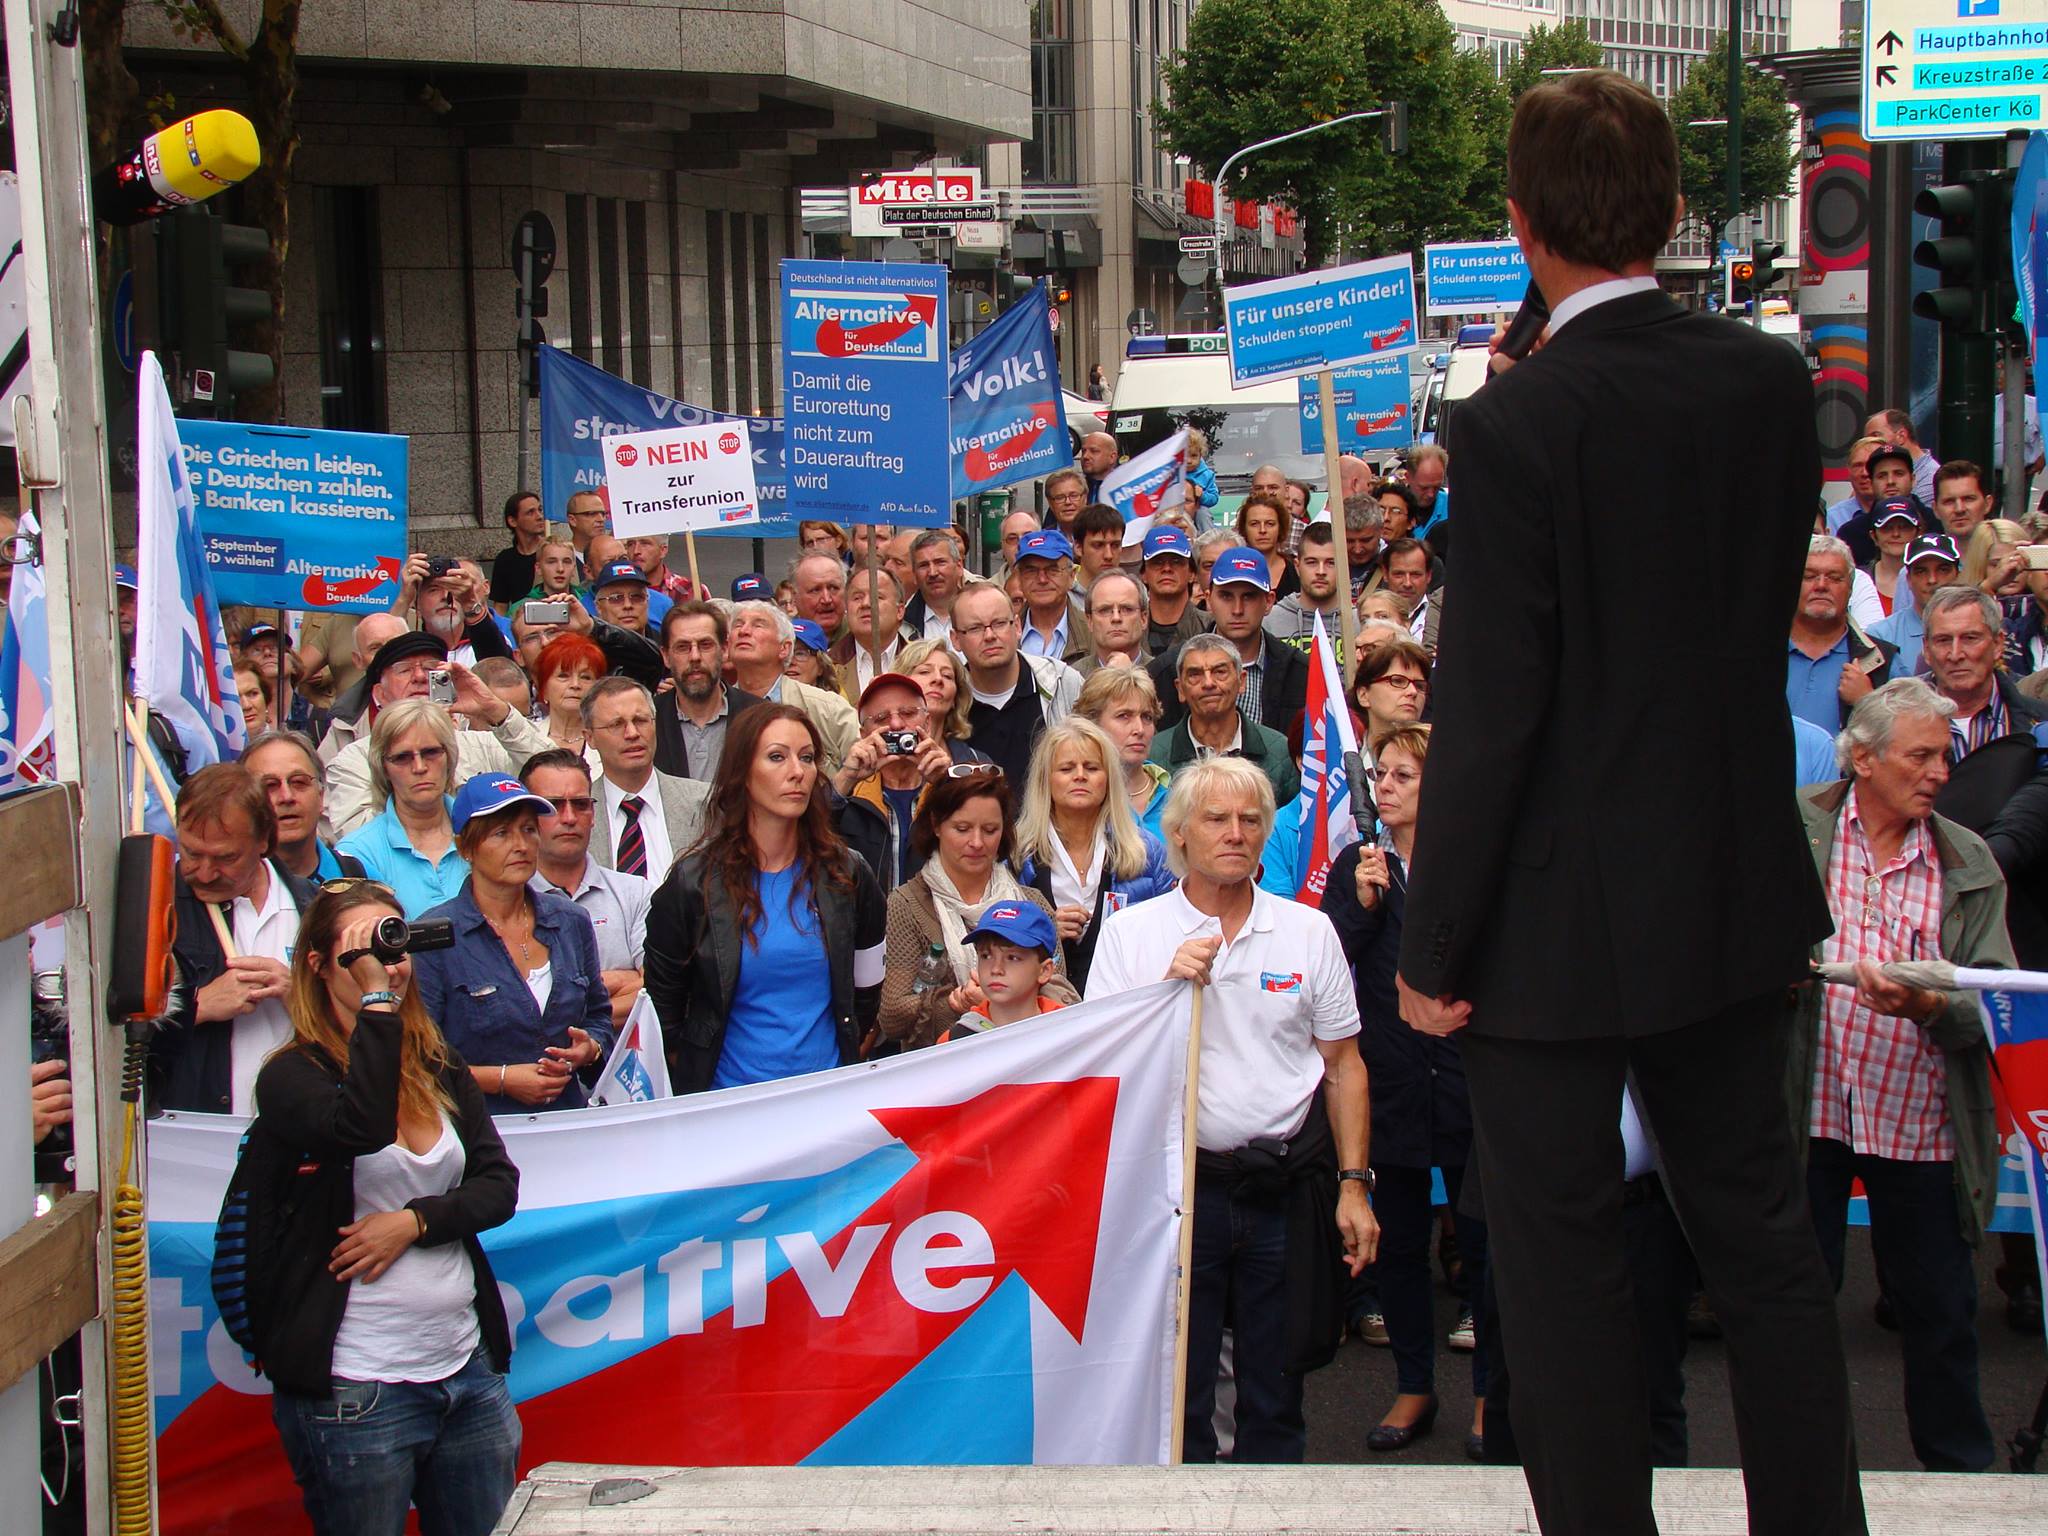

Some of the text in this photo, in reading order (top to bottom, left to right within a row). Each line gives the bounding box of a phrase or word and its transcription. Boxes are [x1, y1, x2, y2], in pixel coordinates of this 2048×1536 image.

[1919, 65, 2034, 85] Kreuzstraße
[1896, 100, 2032, 121] ParkCenter Kö
[864, 180, 968, 201] Miele
[885, 208, 991, 221] Platz der Deutschen Einheit
[1432, 253, 1527, 269] Für unsere Ki
[790, 273, 937, 288] Deutschland ist nicht alternativlos!
[1433, 272, 1521, 284] Schulden stoppen!
[1236, 279, 1405, 327] Für unsere Kinder!
[795, 301, 923, 325] Alternative
[844, 331, 858, 340] für
[1239, 316, 1353, 349] Schulden stoppen!
[1363, 325, 1407, 339] Alternative
[844, 341, 923, 355] Deutschland
[1190, 339, 1227, 351] POL
[962, 350, 1047, 402] Volk!
[1375, 364, 1402, 376] wird.
[792, 371, 872, 392] Damit die
[793, 396, 891, 421] Eurorettung
[1346, 409, 1402, 422] Alternative
[793, 424, 873, 443] nicht zum
[719, 438, 740, 450] STOP
[617, 450, 637, 462] STOP
[647, 440, 709, 466] NEIN
[793, 447, 904, 473] Dauerauftrag
[988, 453, 999, 461] für
[989, 444, 1055, 471] Deutschland
[217, 447, 309, 472] Griechen
[315, 453, 382, 477] leiden.
[187, 467, 393, 500] ie Deutschen zahlen.
[667, 473, 695, 488] zur
[794, 473, 828, 490] wird
[205, 490, 285, 514] Banken
[291, 495, 395, 521] kassieren.
[622, 489, 745, 515] Transferunion
[880, 502, 897, 512] AfD
[210, 538, 277, 554] September
[206, 551, 274, 568] fD wählen!
[285, 559, 389, 581] Alternative
[326, 584, 338, 592] für
[326, 592, 389, 605] Deutschland
